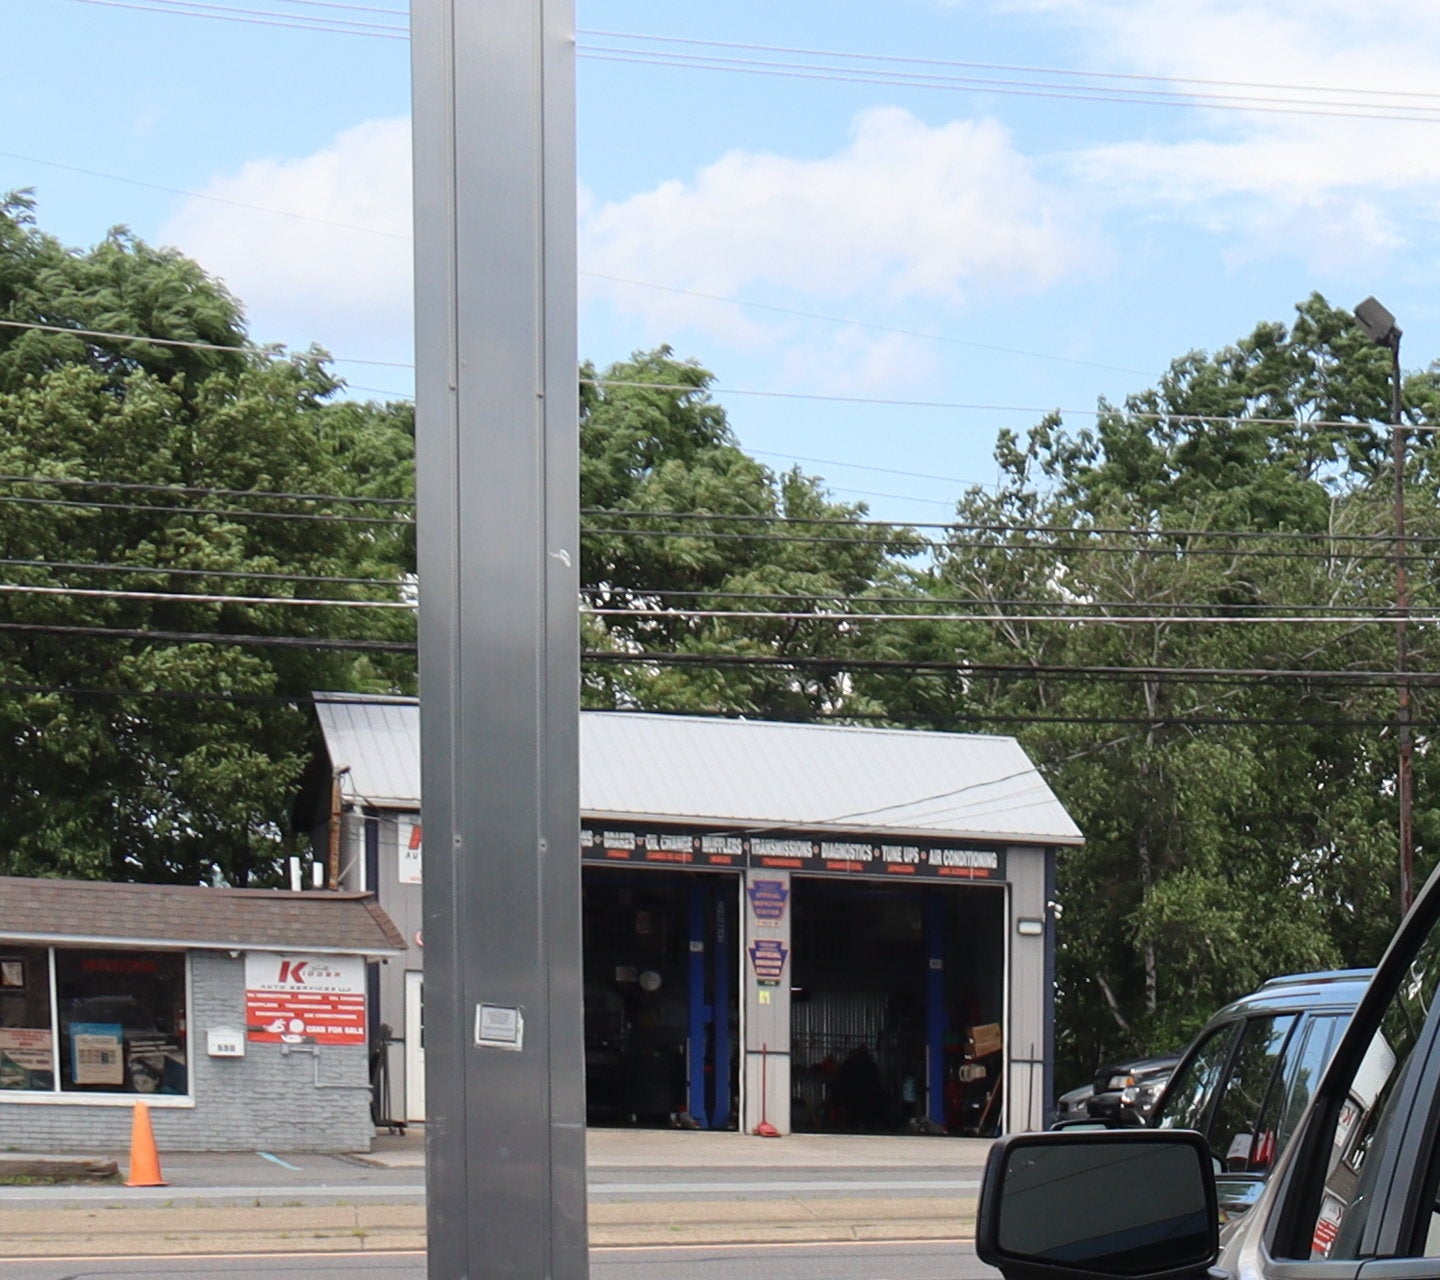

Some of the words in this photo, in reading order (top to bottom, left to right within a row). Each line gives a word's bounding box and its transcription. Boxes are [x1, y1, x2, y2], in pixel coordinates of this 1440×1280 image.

[821, 842, 873, 861] DIAGNOSTICS
[928, 849, 942, 866] AIR
[943, 850, 997, 868] CONDITIONING
